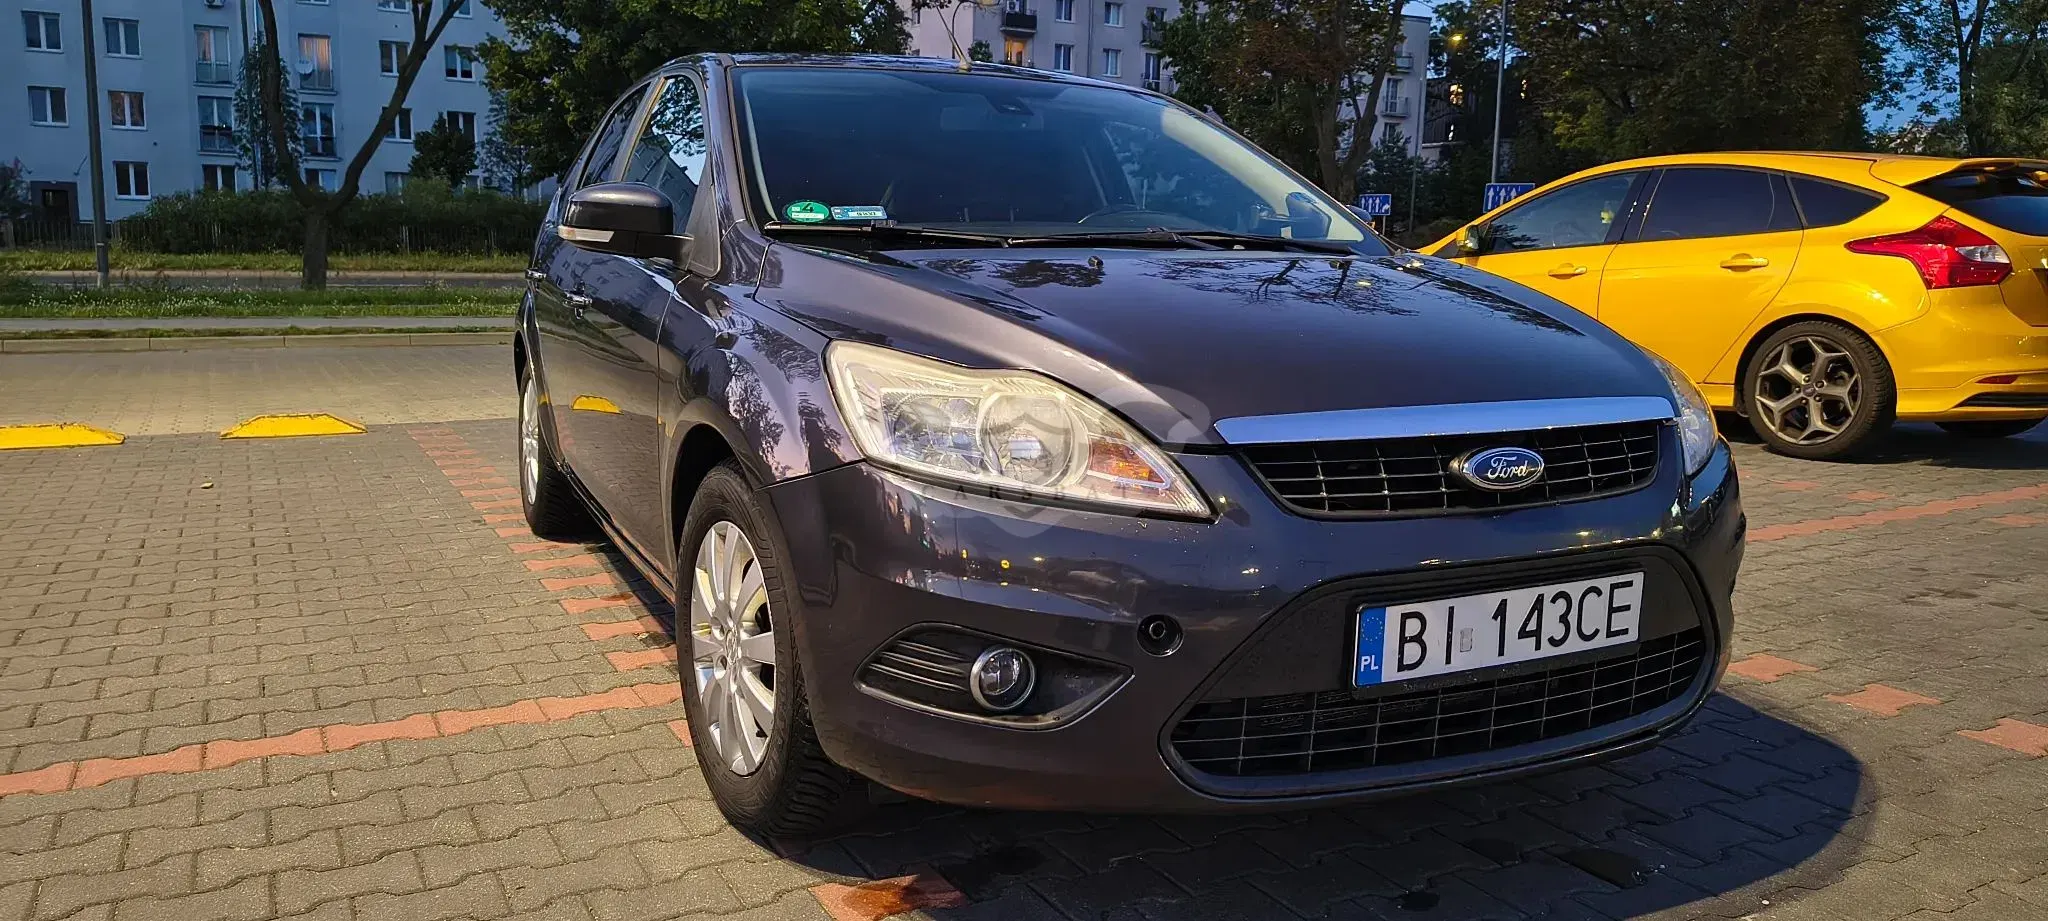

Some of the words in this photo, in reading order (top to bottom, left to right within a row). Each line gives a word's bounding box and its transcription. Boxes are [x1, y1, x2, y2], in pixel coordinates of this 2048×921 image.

[802, 202, 814, 213] 4
[1487, 456, 1528, 479] Ford
[1397, 606, 1455, 673] BI
[1491, 580, 1634, 657] 143CE
[1361, 655, 1379, 671] PL
